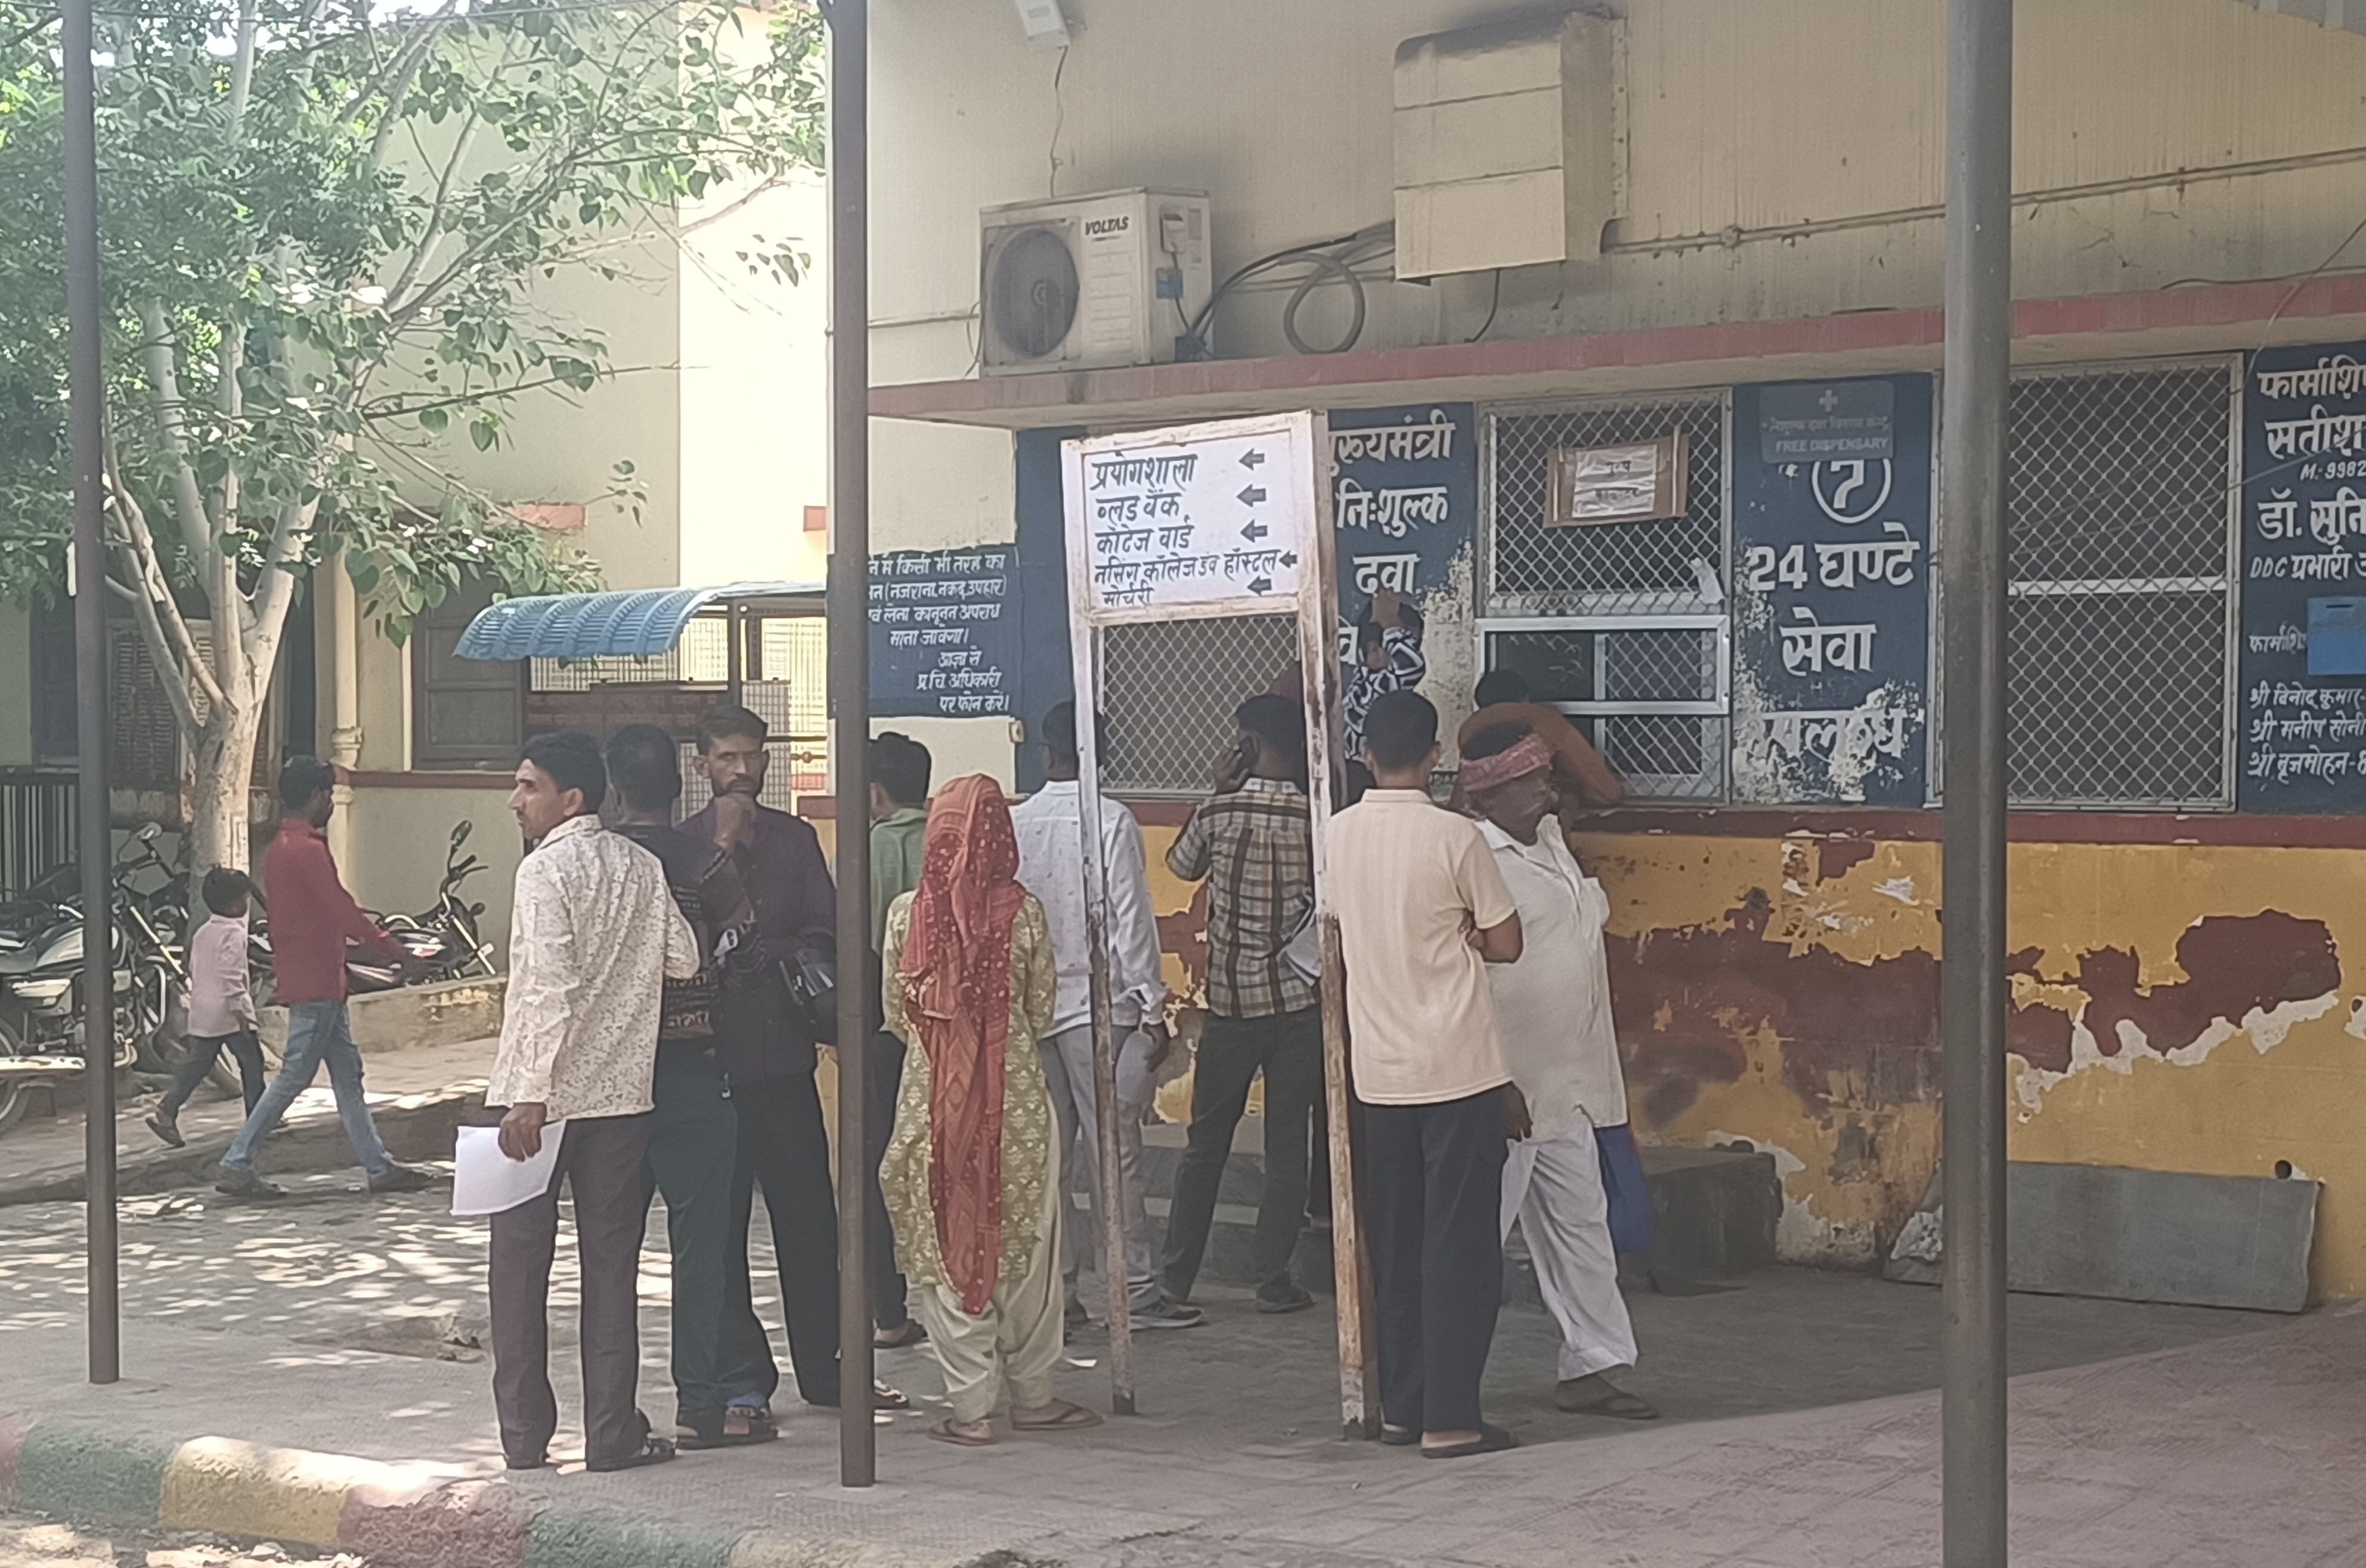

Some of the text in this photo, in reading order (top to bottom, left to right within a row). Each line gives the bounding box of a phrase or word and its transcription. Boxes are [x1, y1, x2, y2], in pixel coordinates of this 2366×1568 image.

[1085, 216, 1129, 235] VOLTAS
[2256, 354, 2366, 399] फार्माशि
[1776, 437, 1888, 453] FREE DISPENSARY
[1159, 515, 1195, 549] वार्ड
[1223, 547, 1282, 582] हॉस्टल
[1352, 553, 1420, 598] दवा
[1748, 544, 1808, 591] 24
[2250, 556, 2288, 578] DDC
[2290, 544, 2353, 581] प्रभारी
[1779, 607, 1877, 677] सेवा
[2250, 680, 2271, 709] श्री
[2249, 709, 2278, 742] श्री
[2247, 742, 2277, 777] श्री
